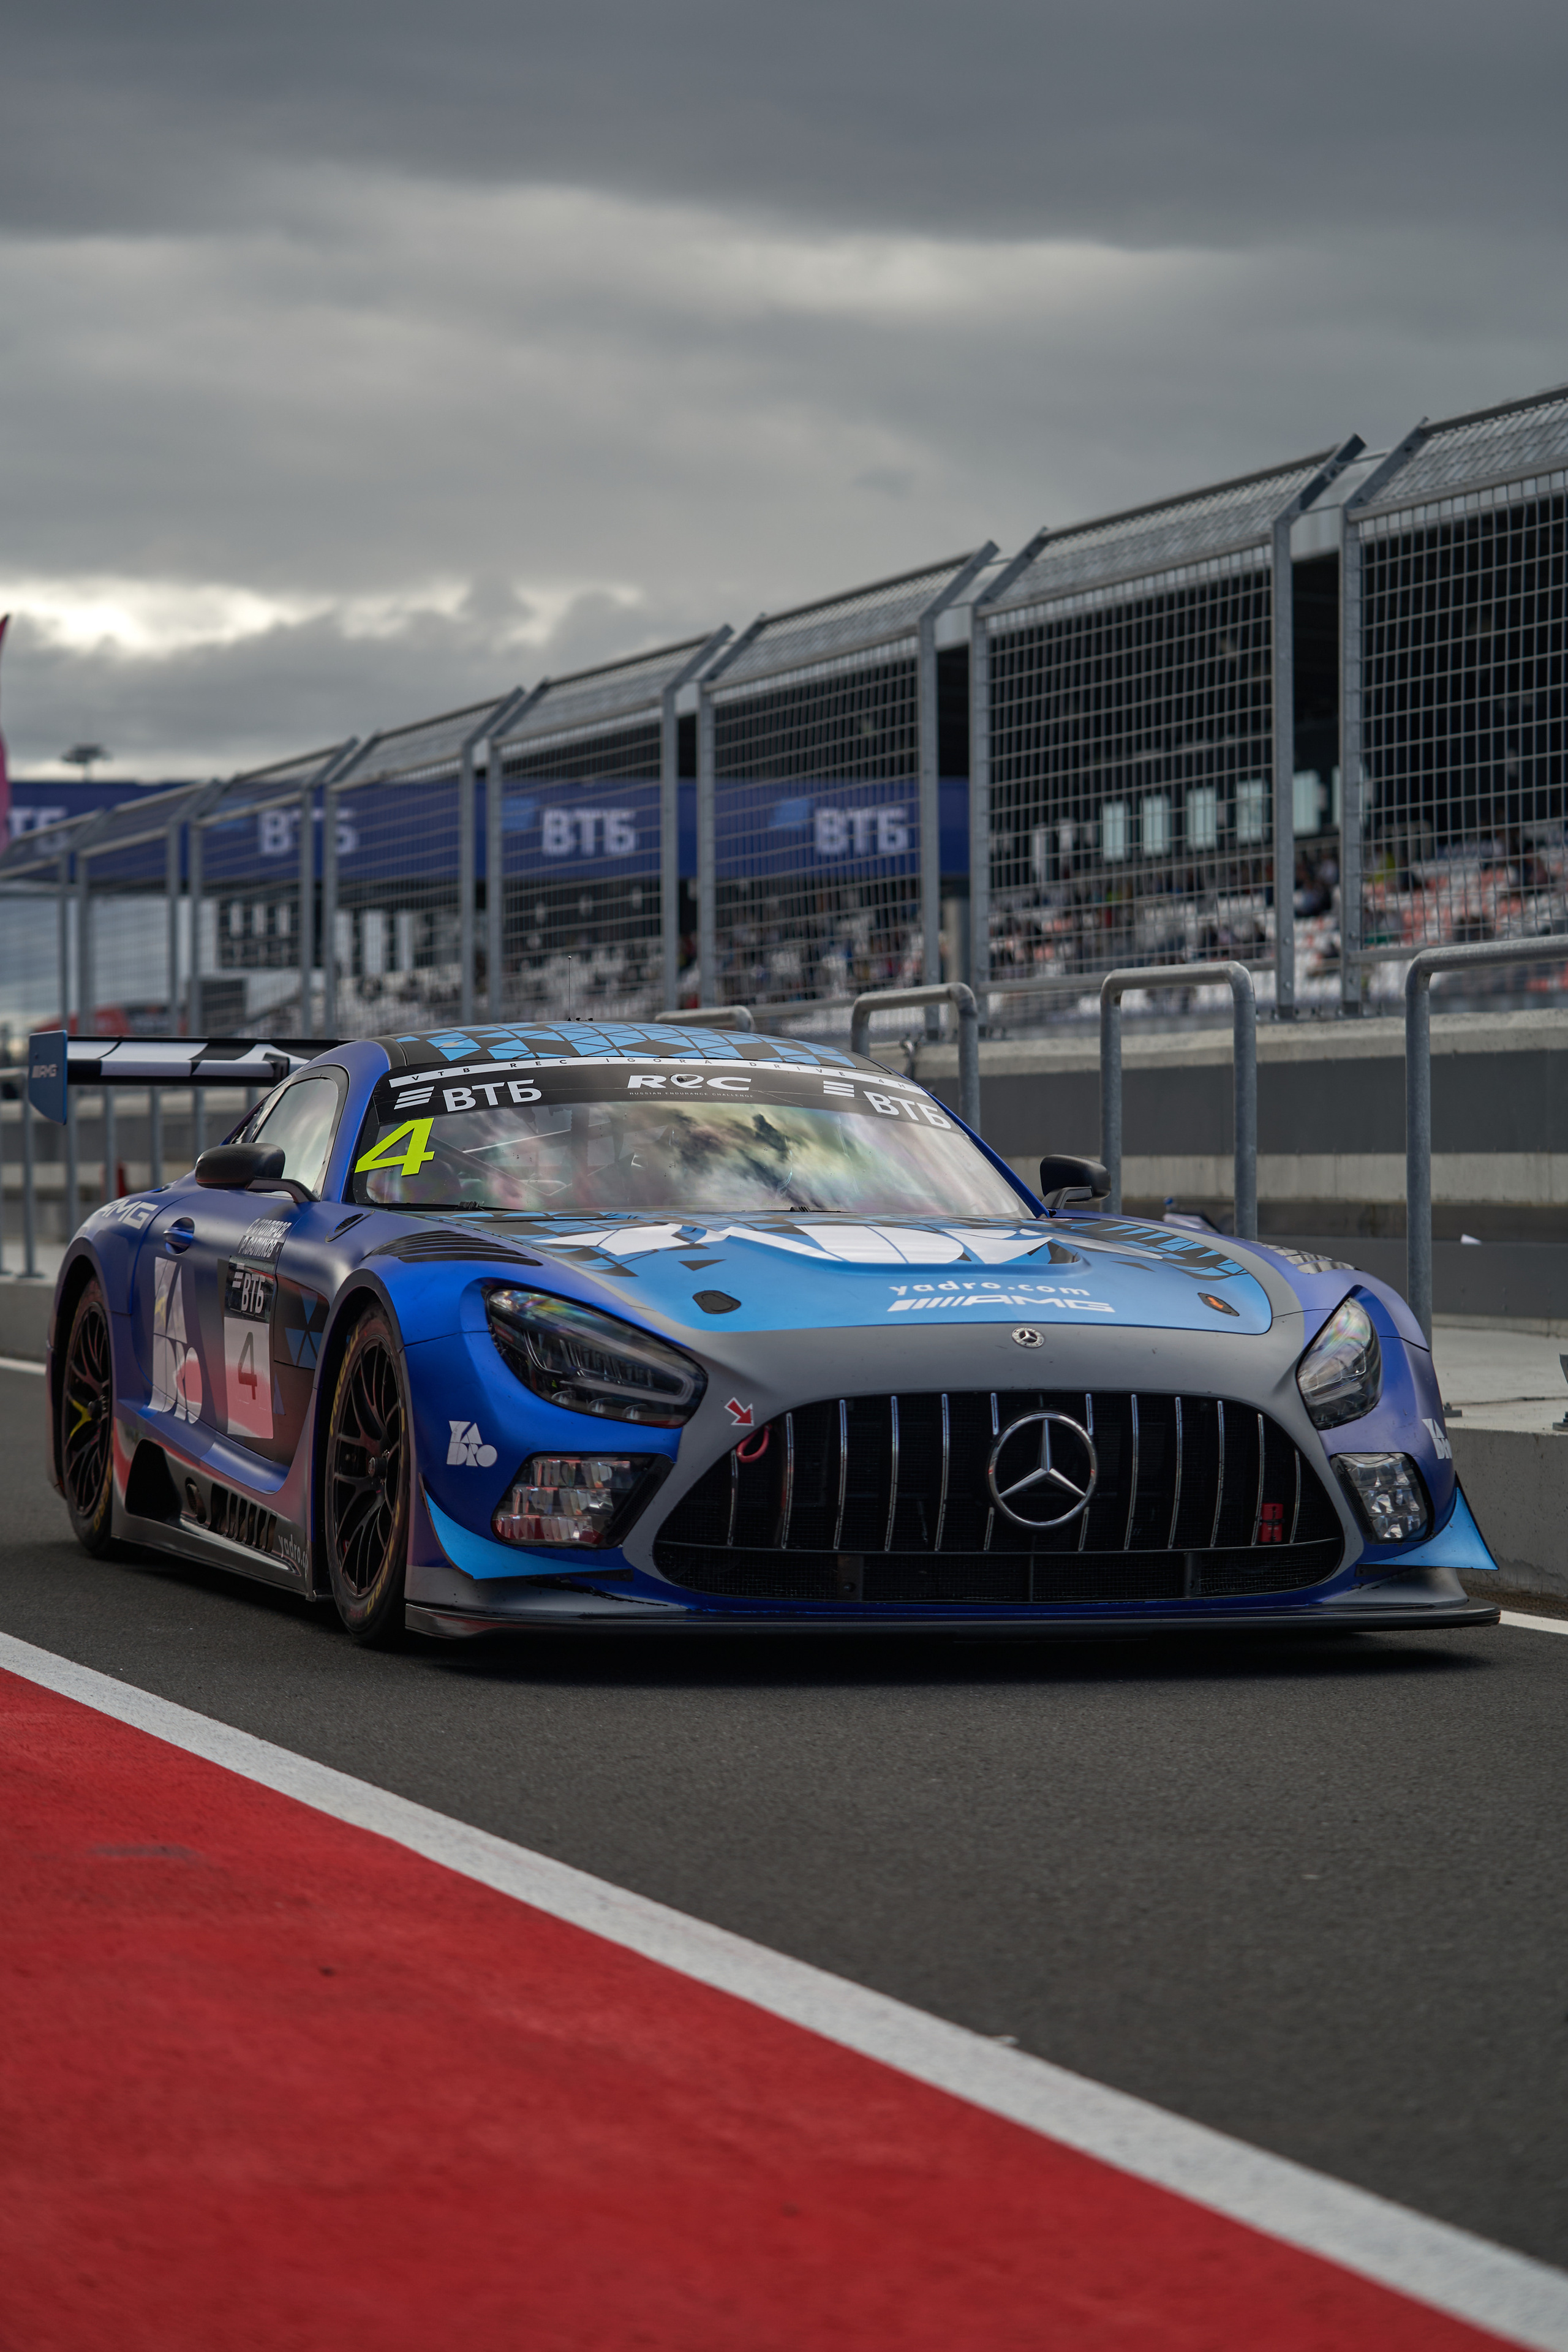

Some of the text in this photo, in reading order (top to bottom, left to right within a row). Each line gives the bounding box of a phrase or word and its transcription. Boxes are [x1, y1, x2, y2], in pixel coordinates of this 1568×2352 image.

[541, 808, 637, 856] ВТБ
[814, 807, 909, 856] ВТБ
[412, 1068, 470, 1080] VTB
[510, 1059, 568, 1068] REC
[749, 1061, 846, 1077] DRIVE
[442, 1079, 542, 1112] ВТБ
[863, 1090, 952, 1129] ВТБ
[354, 1117, 435, 1176] 4
[241, 1272, 266, 1314] ВТБ
[889, 1281, 1090, 1296] yadro.com
[238, 1332, 258, 1400] 4
